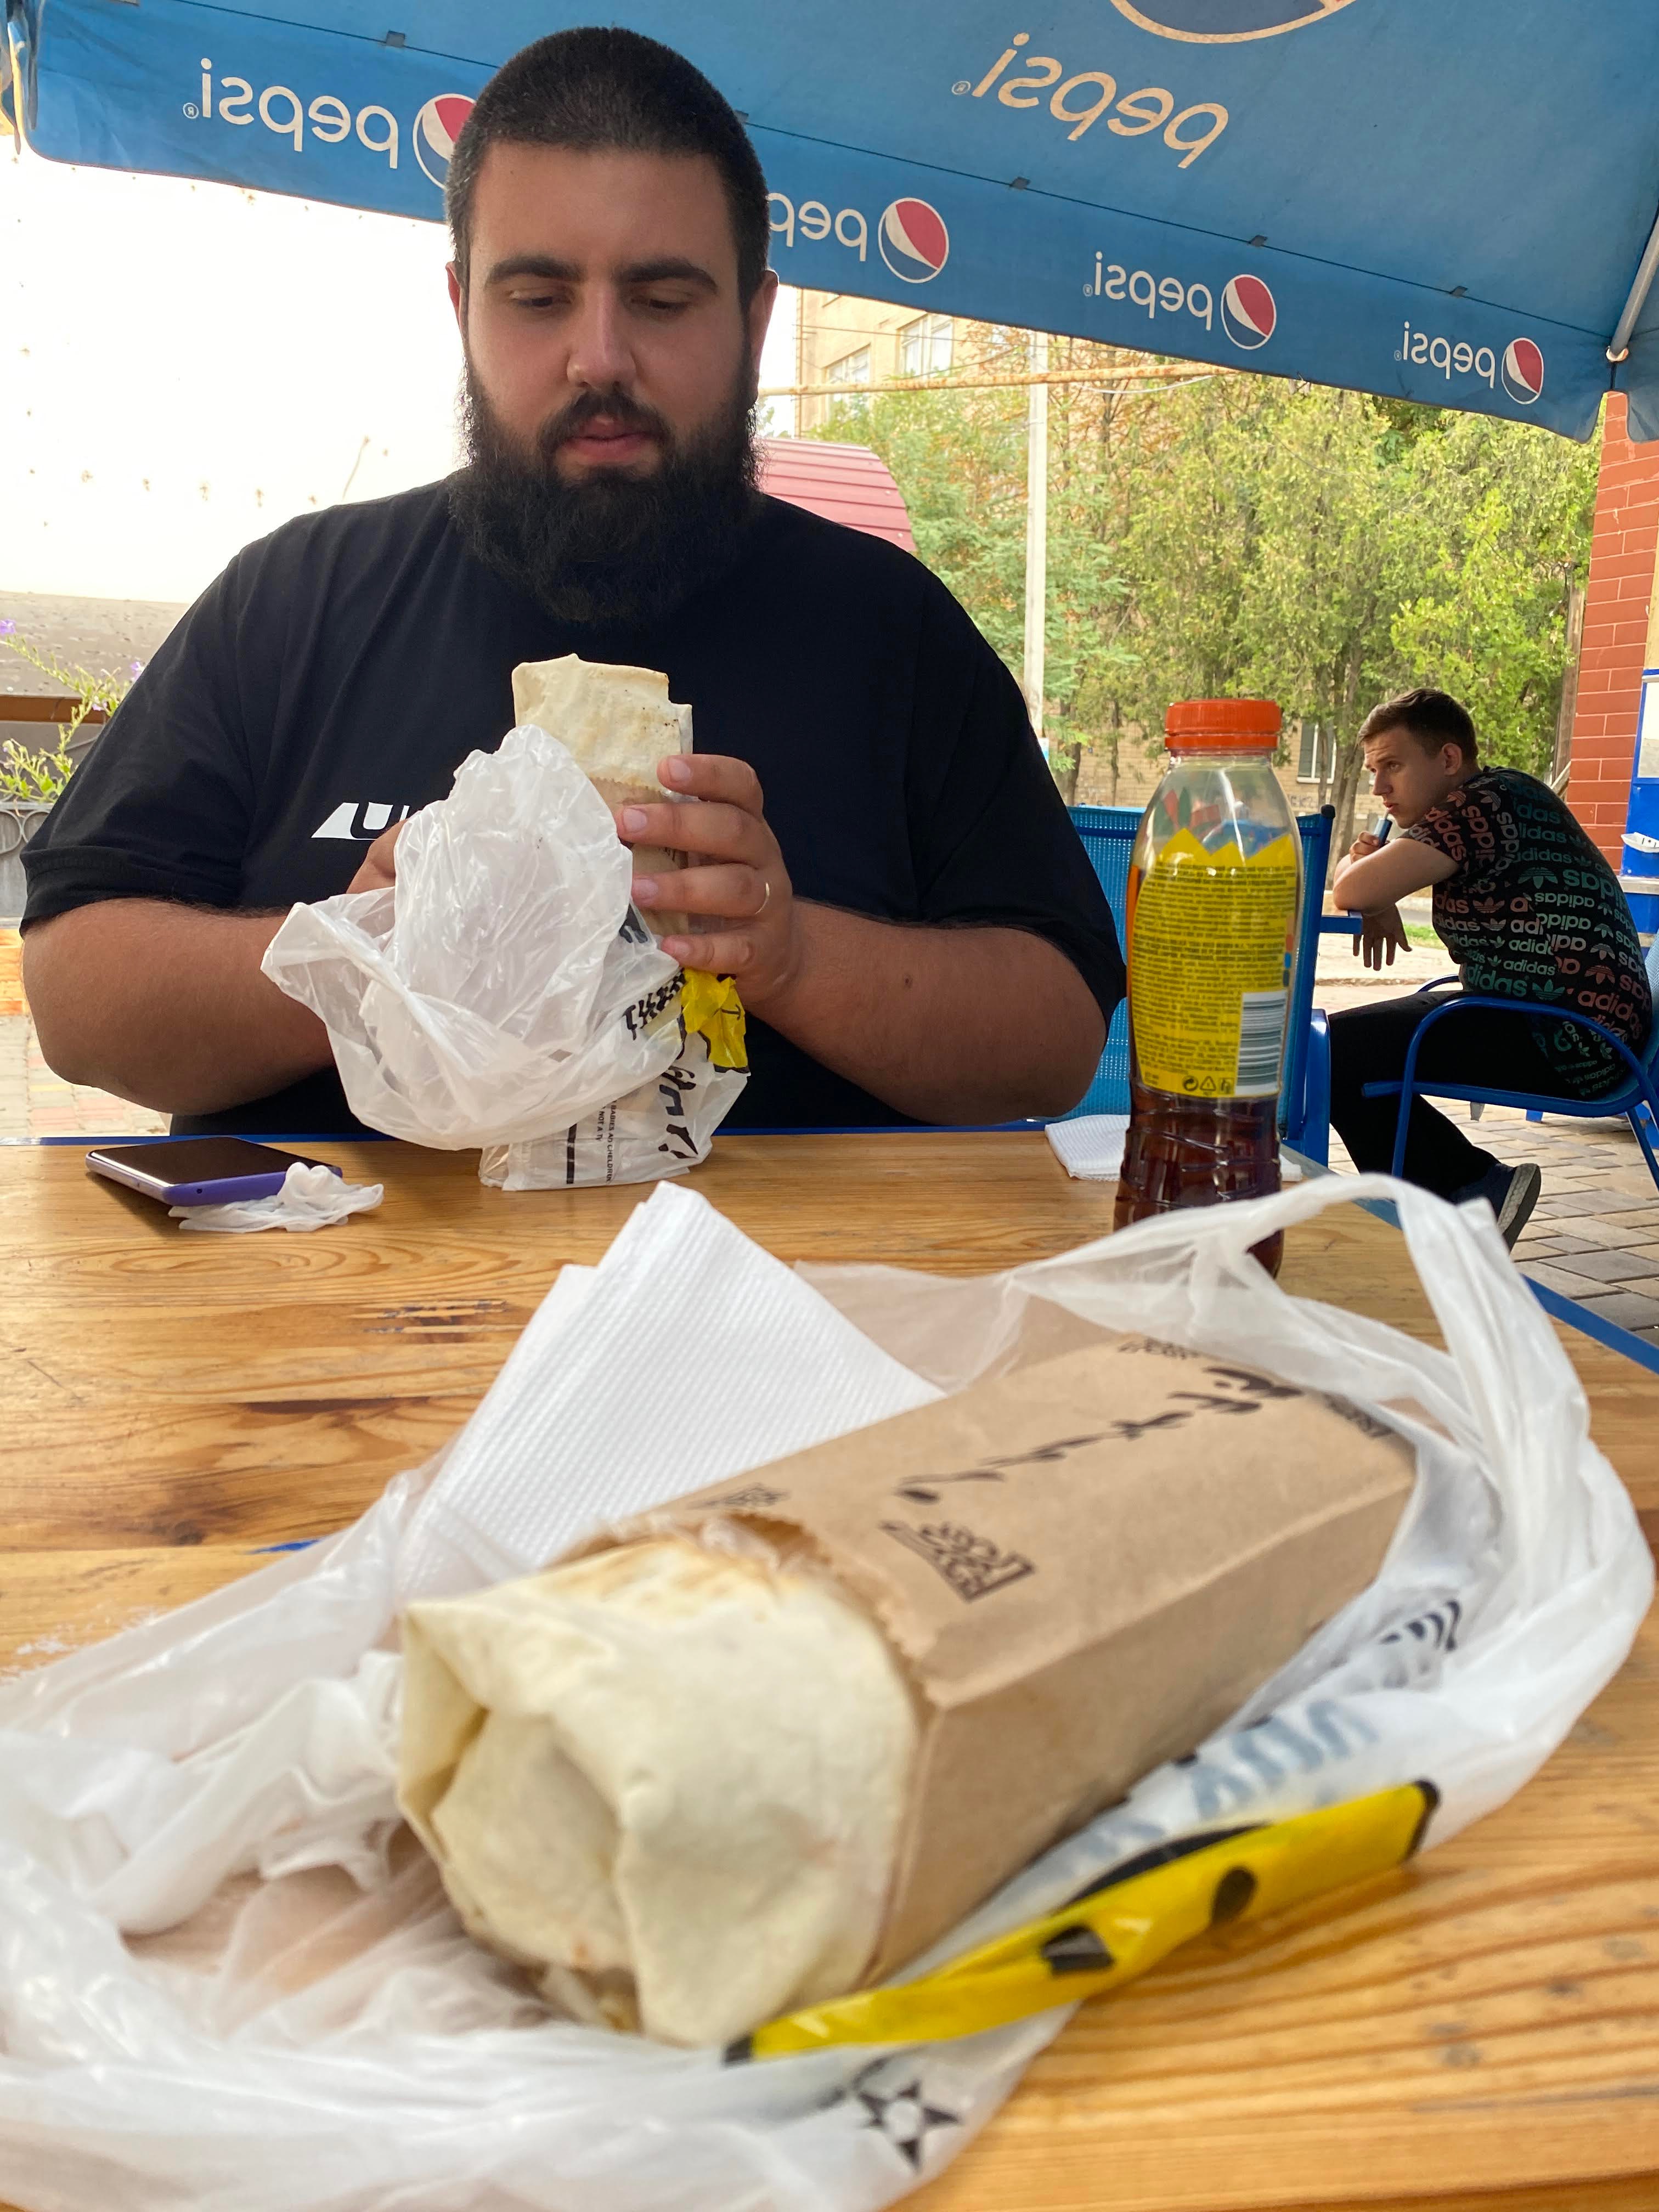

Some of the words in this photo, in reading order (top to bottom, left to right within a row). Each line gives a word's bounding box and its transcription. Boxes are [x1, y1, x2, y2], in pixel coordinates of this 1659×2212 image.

[1534, 892, 1595, 909] adidas
[1503, 959, 1556, 976] adidas
[597, 1111, 606, 1125] NOT
[608, 1104, 617, 1131] BABIES
